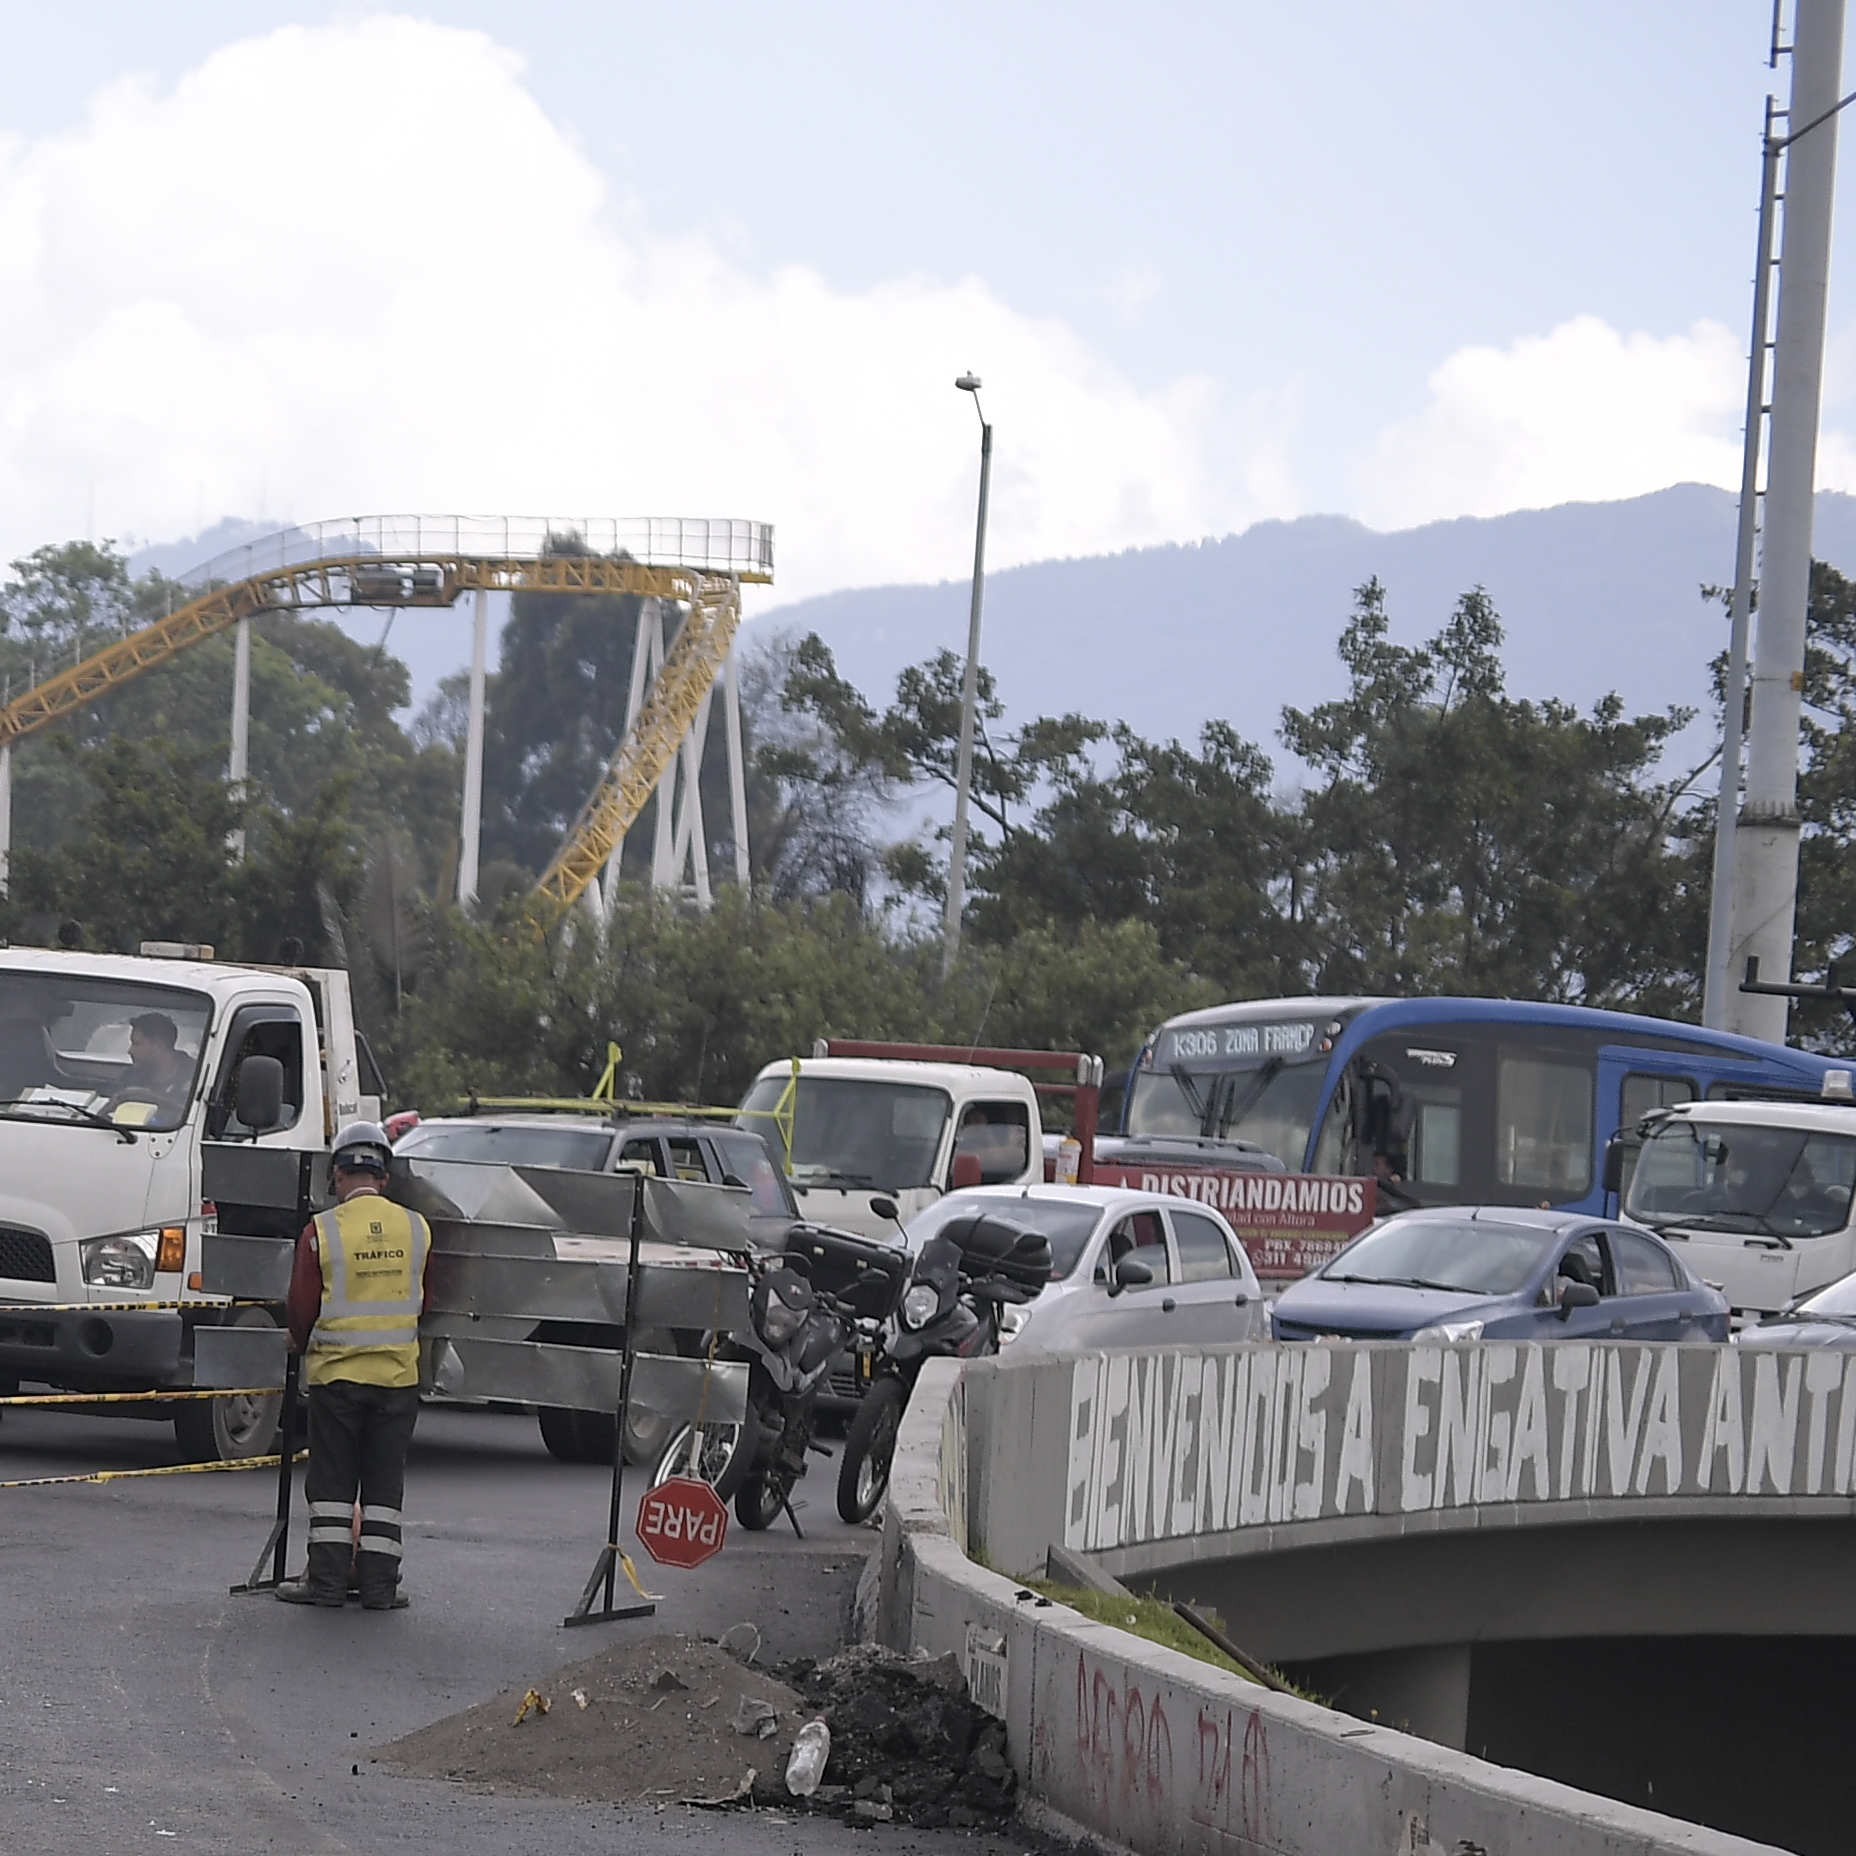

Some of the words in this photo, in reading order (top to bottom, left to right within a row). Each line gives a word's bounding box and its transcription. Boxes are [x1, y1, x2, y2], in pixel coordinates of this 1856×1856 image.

[1173, 1029, 1217, 1058] K306
[1335, 1350, 1375, 1515] A
[1401, 1341, 1683, 1511] ENGATIVA
[645, 1501, 720, 1546] PARE
